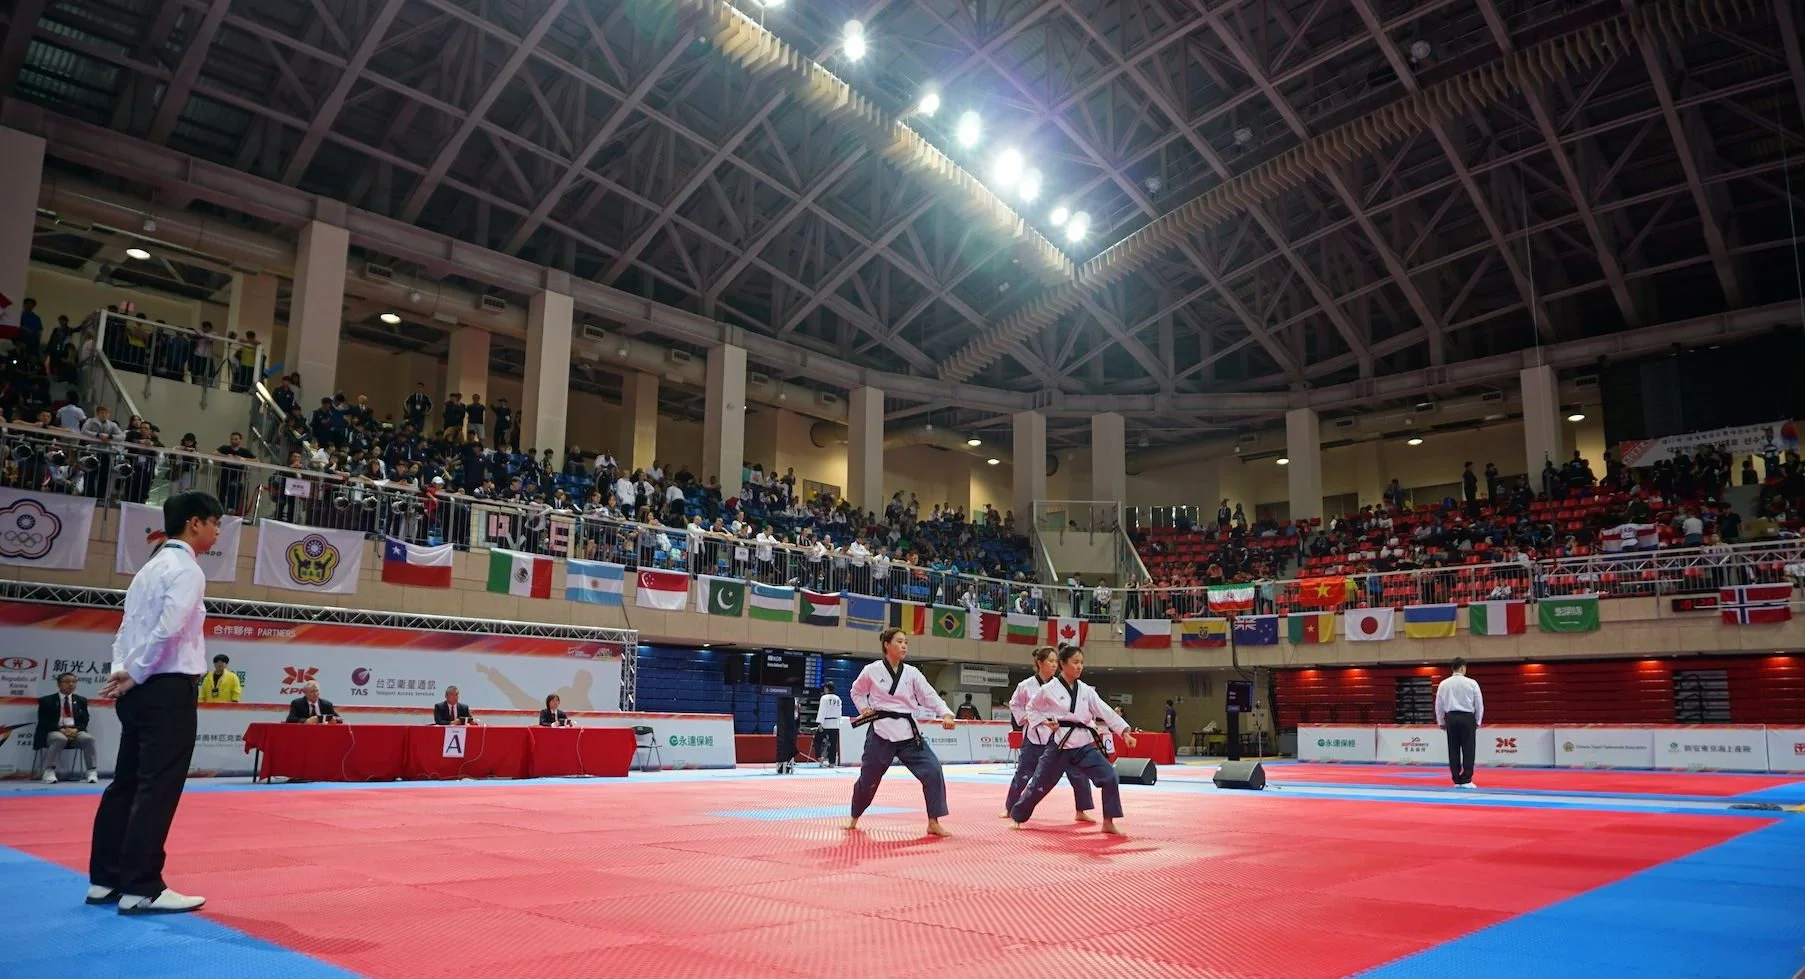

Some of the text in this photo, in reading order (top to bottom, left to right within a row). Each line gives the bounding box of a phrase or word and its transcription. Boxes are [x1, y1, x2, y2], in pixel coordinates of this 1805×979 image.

[214, 625, 296, 638] 合作夥伴 PARTNERS
[350, 688, 369, 696] TAS
[445, 734, 462, 754] A
